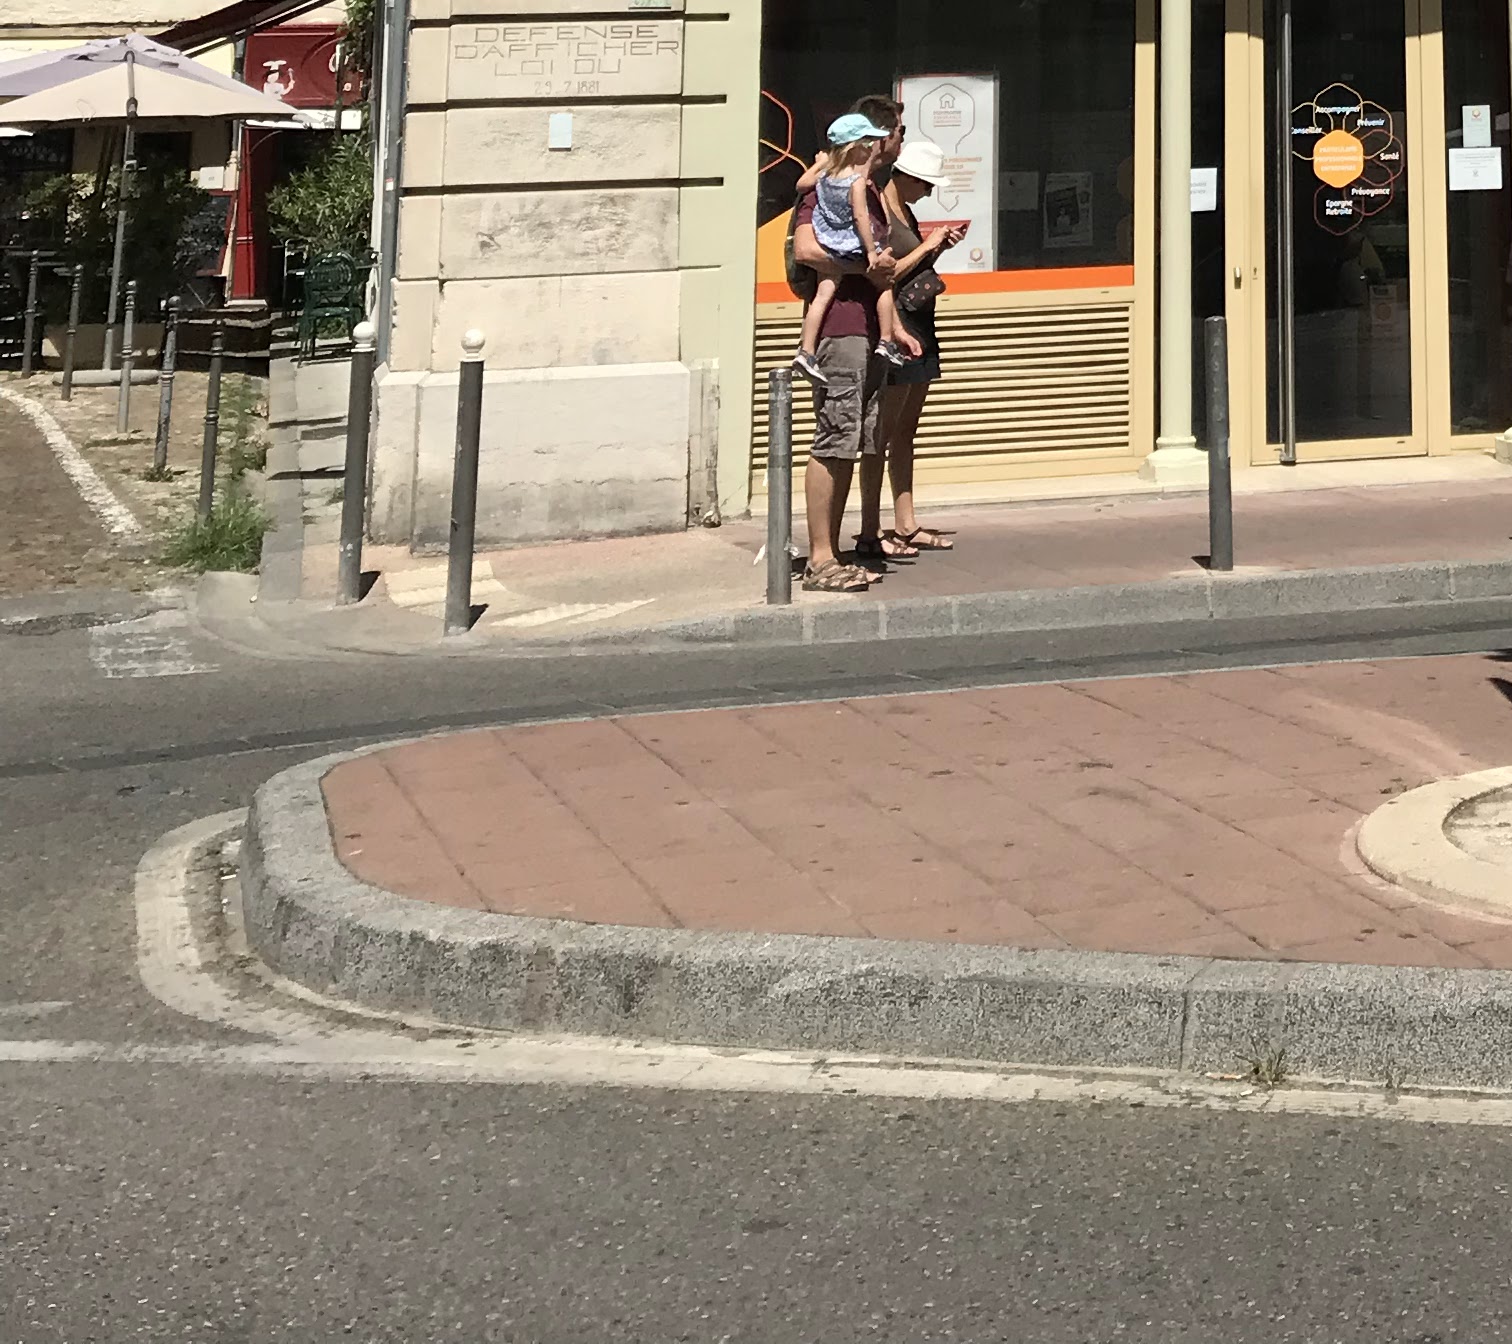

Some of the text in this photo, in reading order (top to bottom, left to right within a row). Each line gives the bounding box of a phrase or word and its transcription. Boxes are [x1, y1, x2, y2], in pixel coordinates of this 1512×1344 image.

[474, 24, 659, 43] DEFENSE
[494, 58, 621, 76] LOI DU
[1380, 152, 1399, 160] Santé
[1351, 188, 1390, 197] Prévoyance
